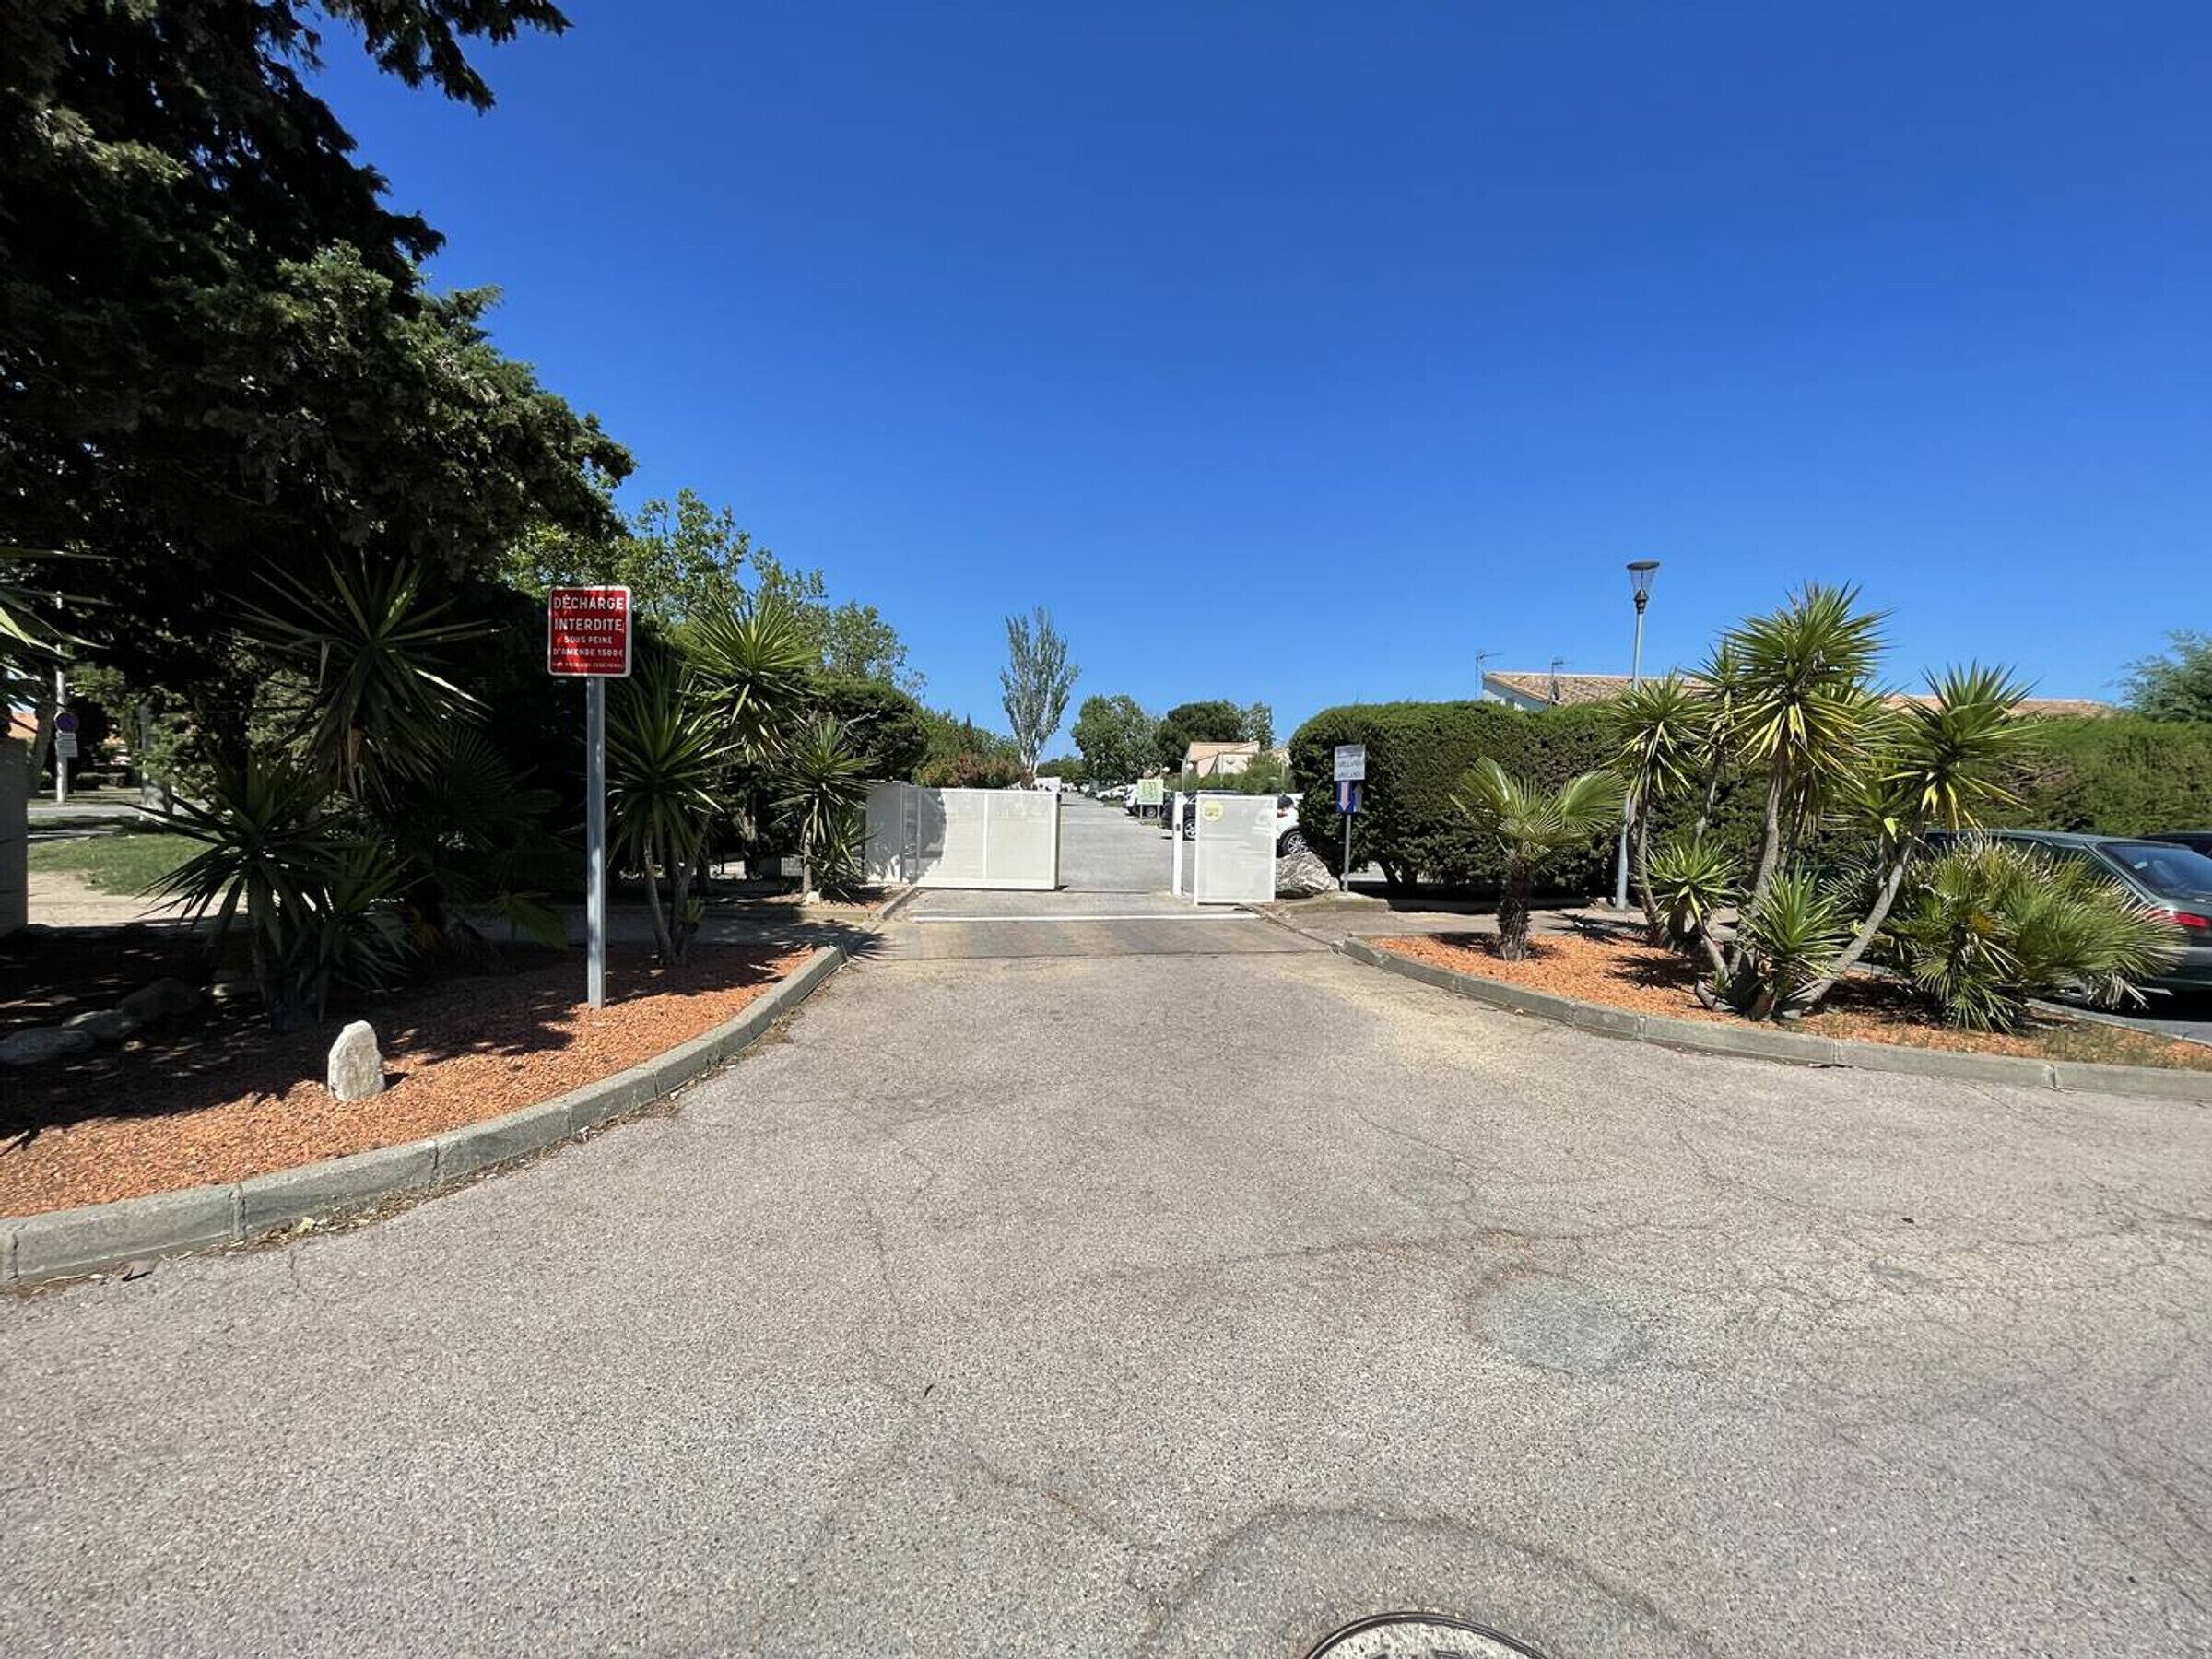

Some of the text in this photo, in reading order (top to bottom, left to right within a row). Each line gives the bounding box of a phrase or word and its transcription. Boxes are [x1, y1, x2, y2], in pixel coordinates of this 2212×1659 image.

[553, 594, 625, 610] DÉCHARGE
[554, 618, 624, 631] INTERDITE
[588, 636, 612, 644] PEINE
